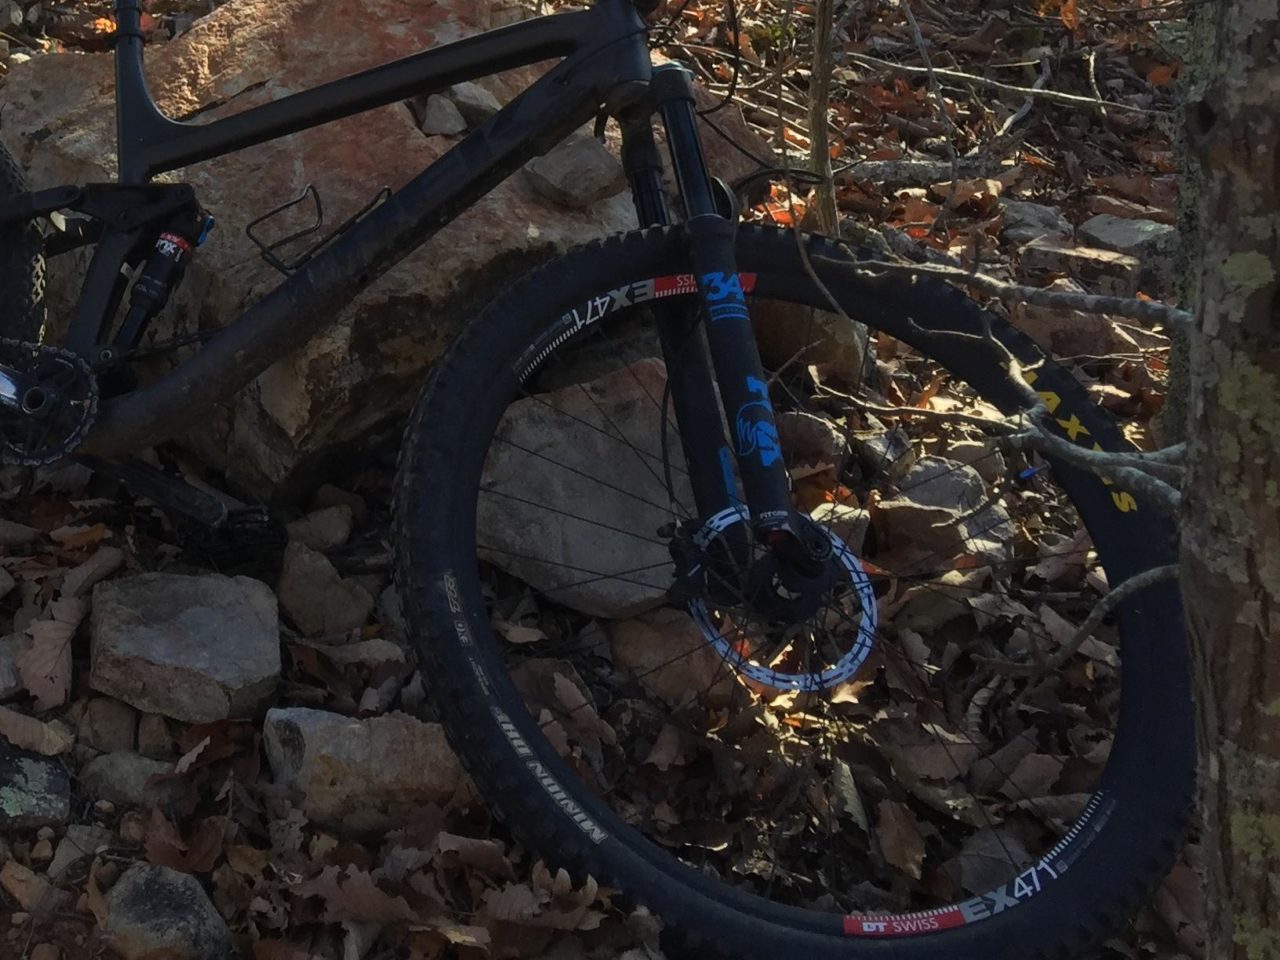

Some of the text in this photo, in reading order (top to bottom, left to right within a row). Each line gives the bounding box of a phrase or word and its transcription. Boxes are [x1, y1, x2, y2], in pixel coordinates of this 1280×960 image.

[571, 279, 655, 330] EX471
[526, 760, 608, 844] MINION
[959, 859, 1058, 924] EX471
[862, 917, 939, 933] DT SWISS
